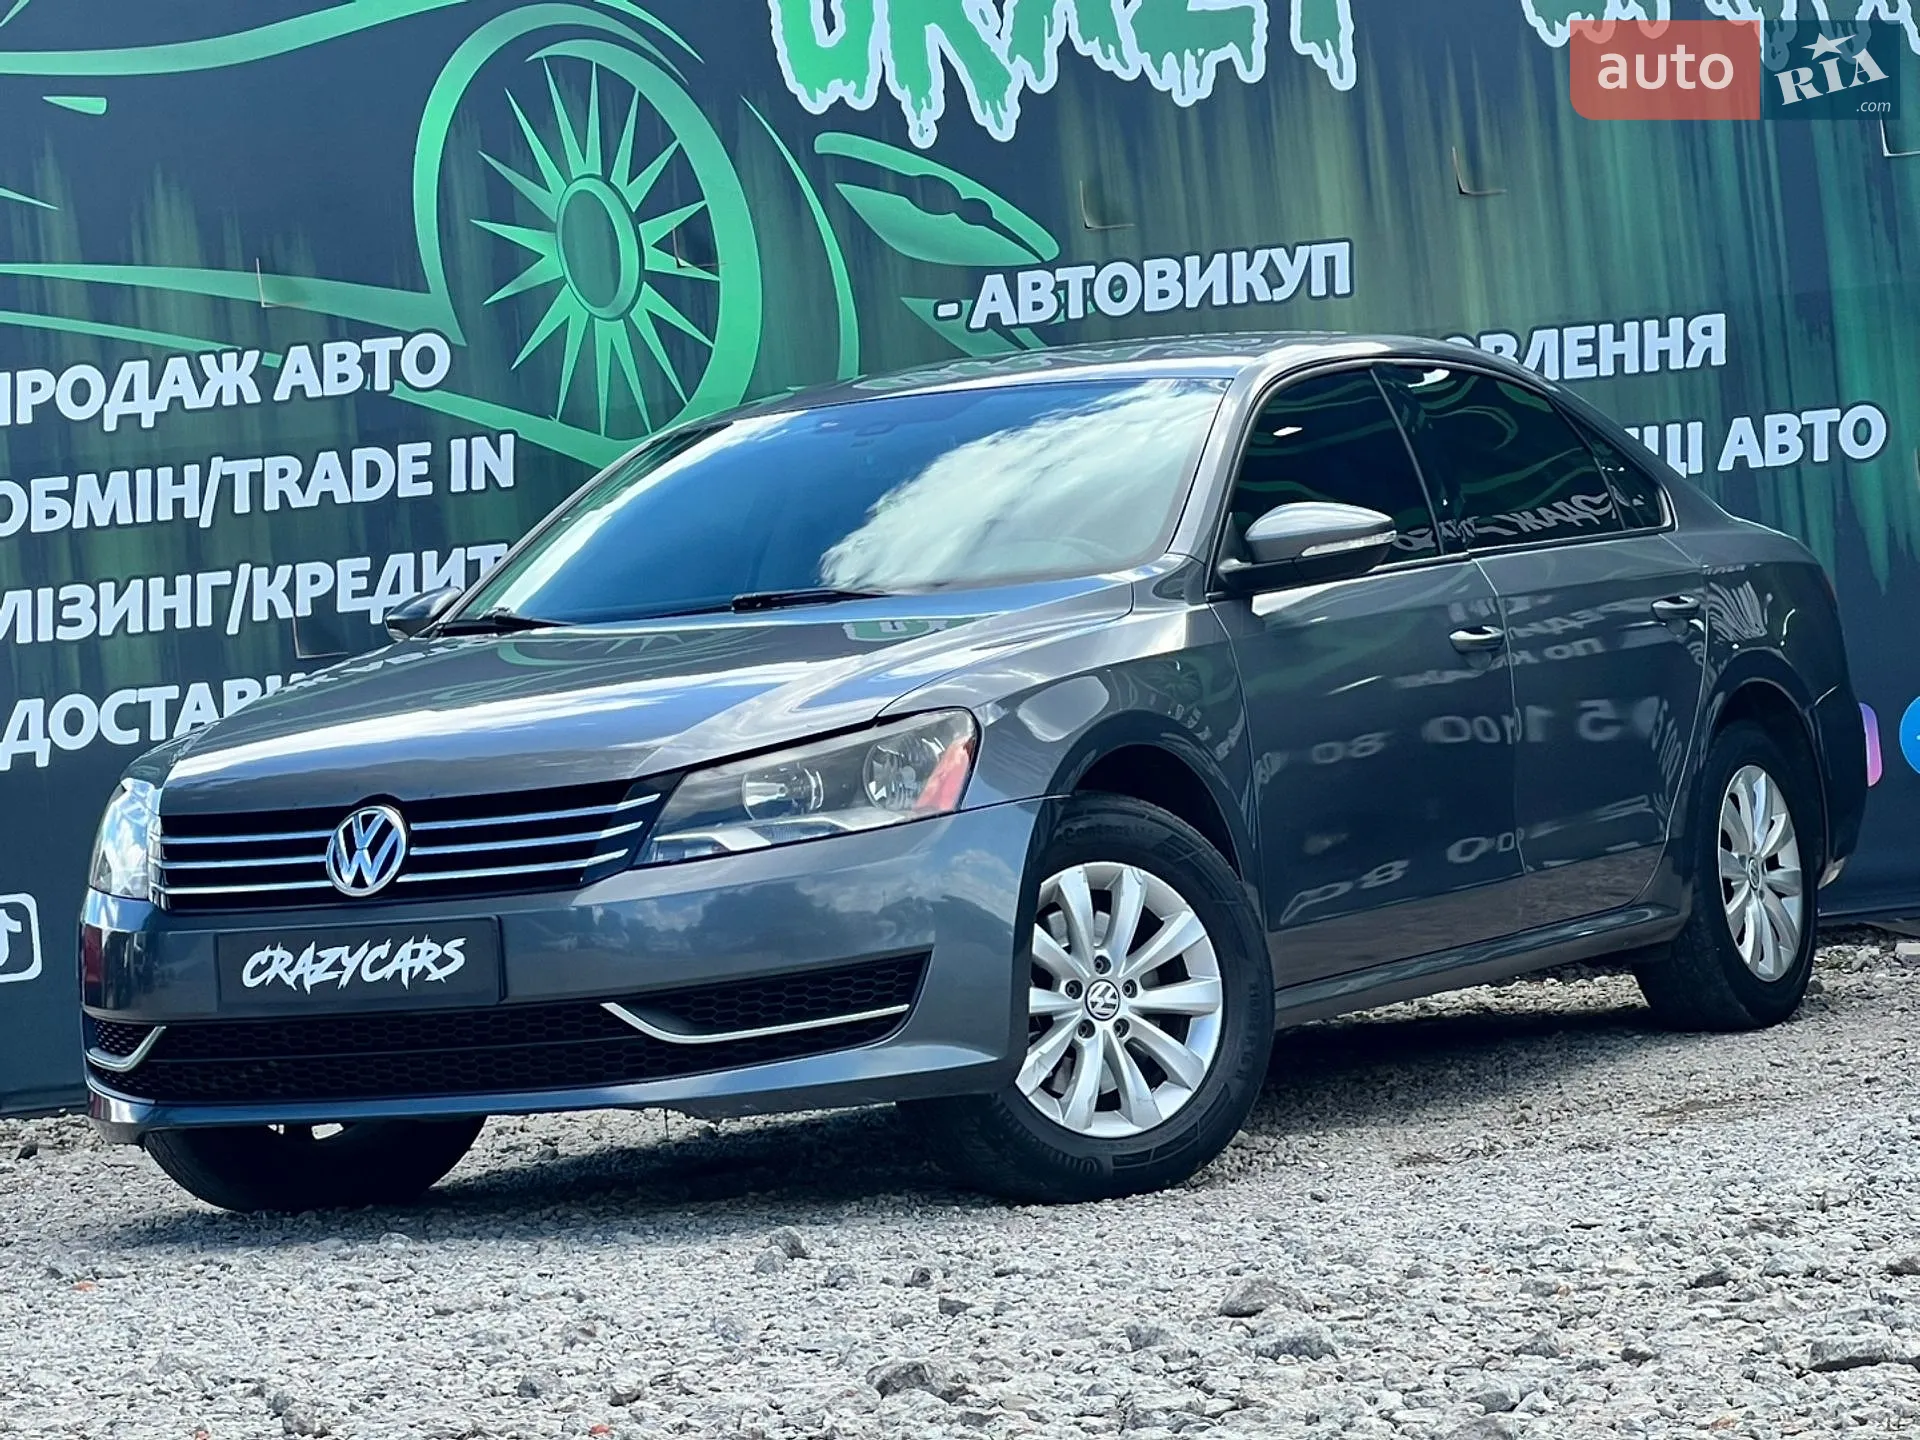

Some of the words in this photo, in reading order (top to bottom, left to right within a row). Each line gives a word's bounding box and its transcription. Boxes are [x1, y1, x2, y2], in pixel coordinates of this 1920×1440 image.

[970, 241, 1351, 329] АВТОВИКУП
[0, 349, 261, 432] РОДАЖ
[273, 332, 451, 401] АВТО
[450, 433, 514, 492] IN
[1717, 404, 1887, 472] АВТО
[242, 934, 467, 995] CRAZYCARS
